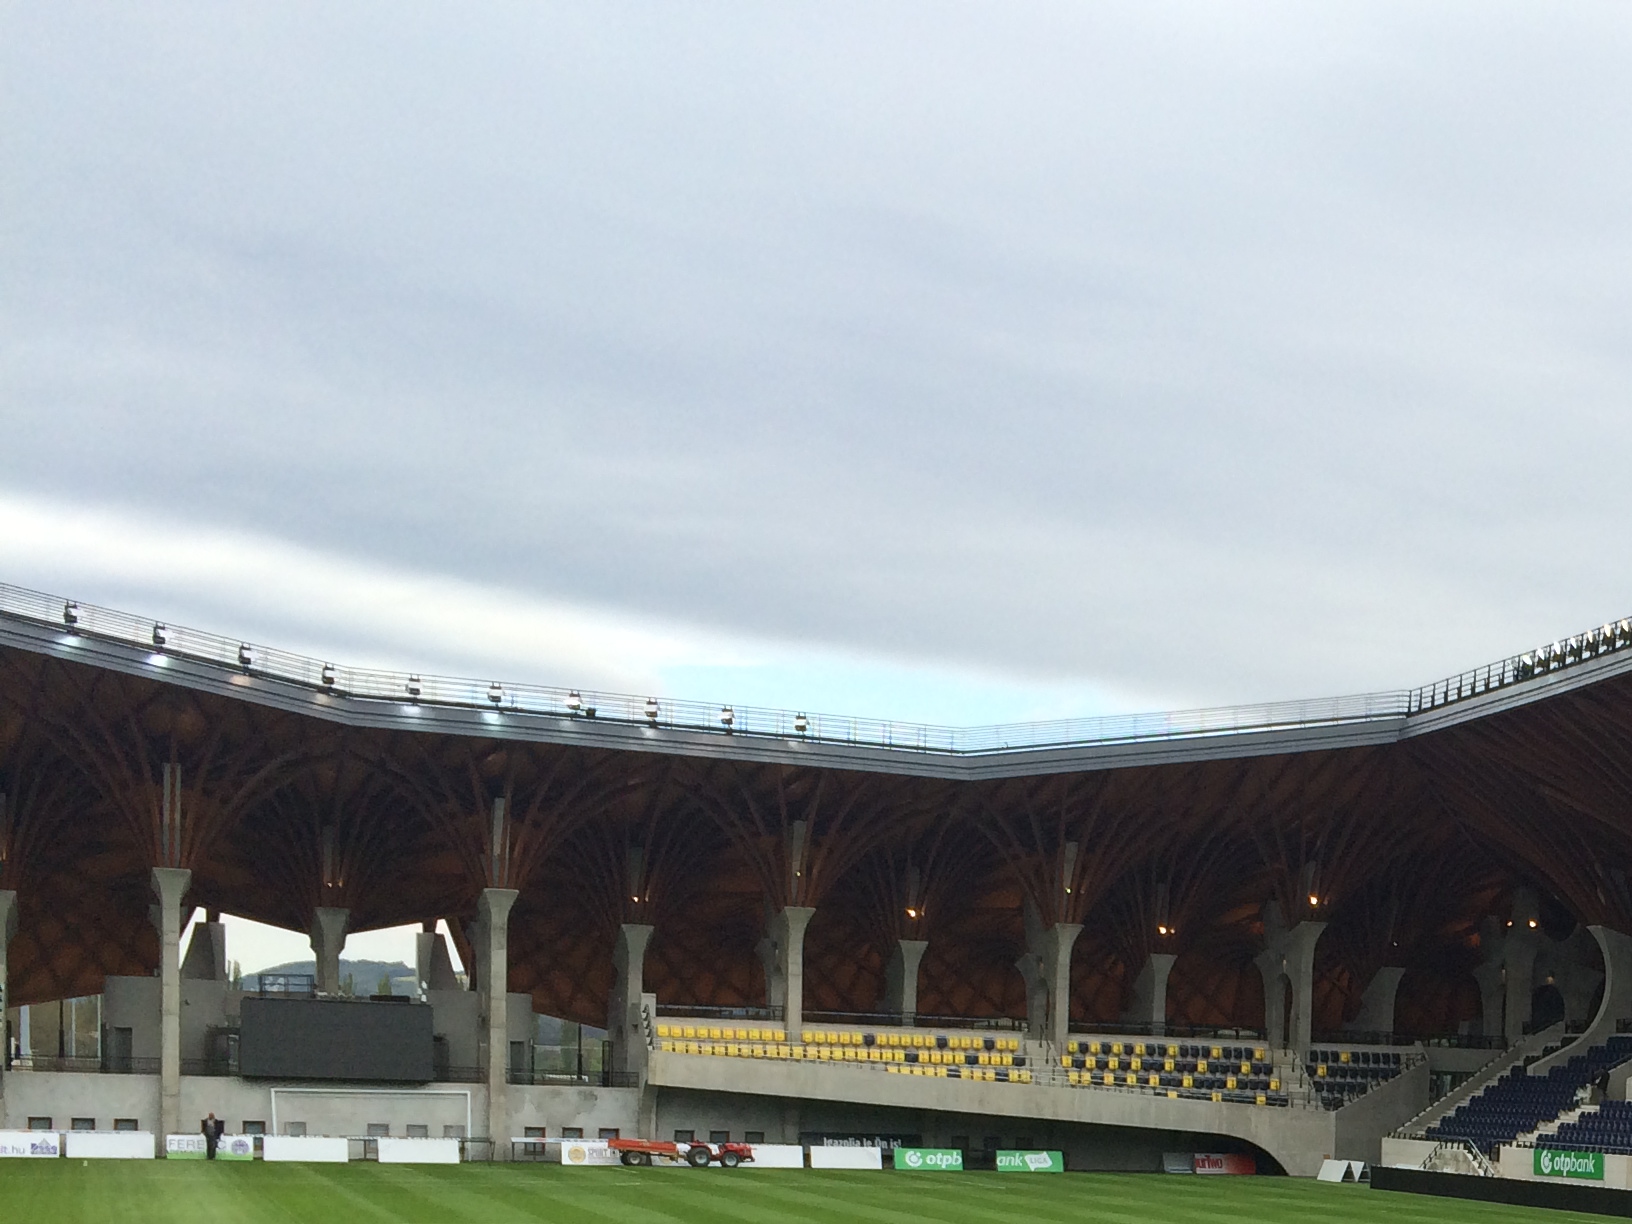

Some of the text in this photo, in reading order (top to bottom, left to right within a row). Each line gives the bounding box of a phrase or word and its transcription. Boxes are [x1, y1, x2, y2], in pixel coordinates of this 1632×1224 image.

[926, 1151, 962, 1169] otpb
[996, 1152, 1023, 1167] ank
[1553, 1151, 1595, 1177] otpbank
